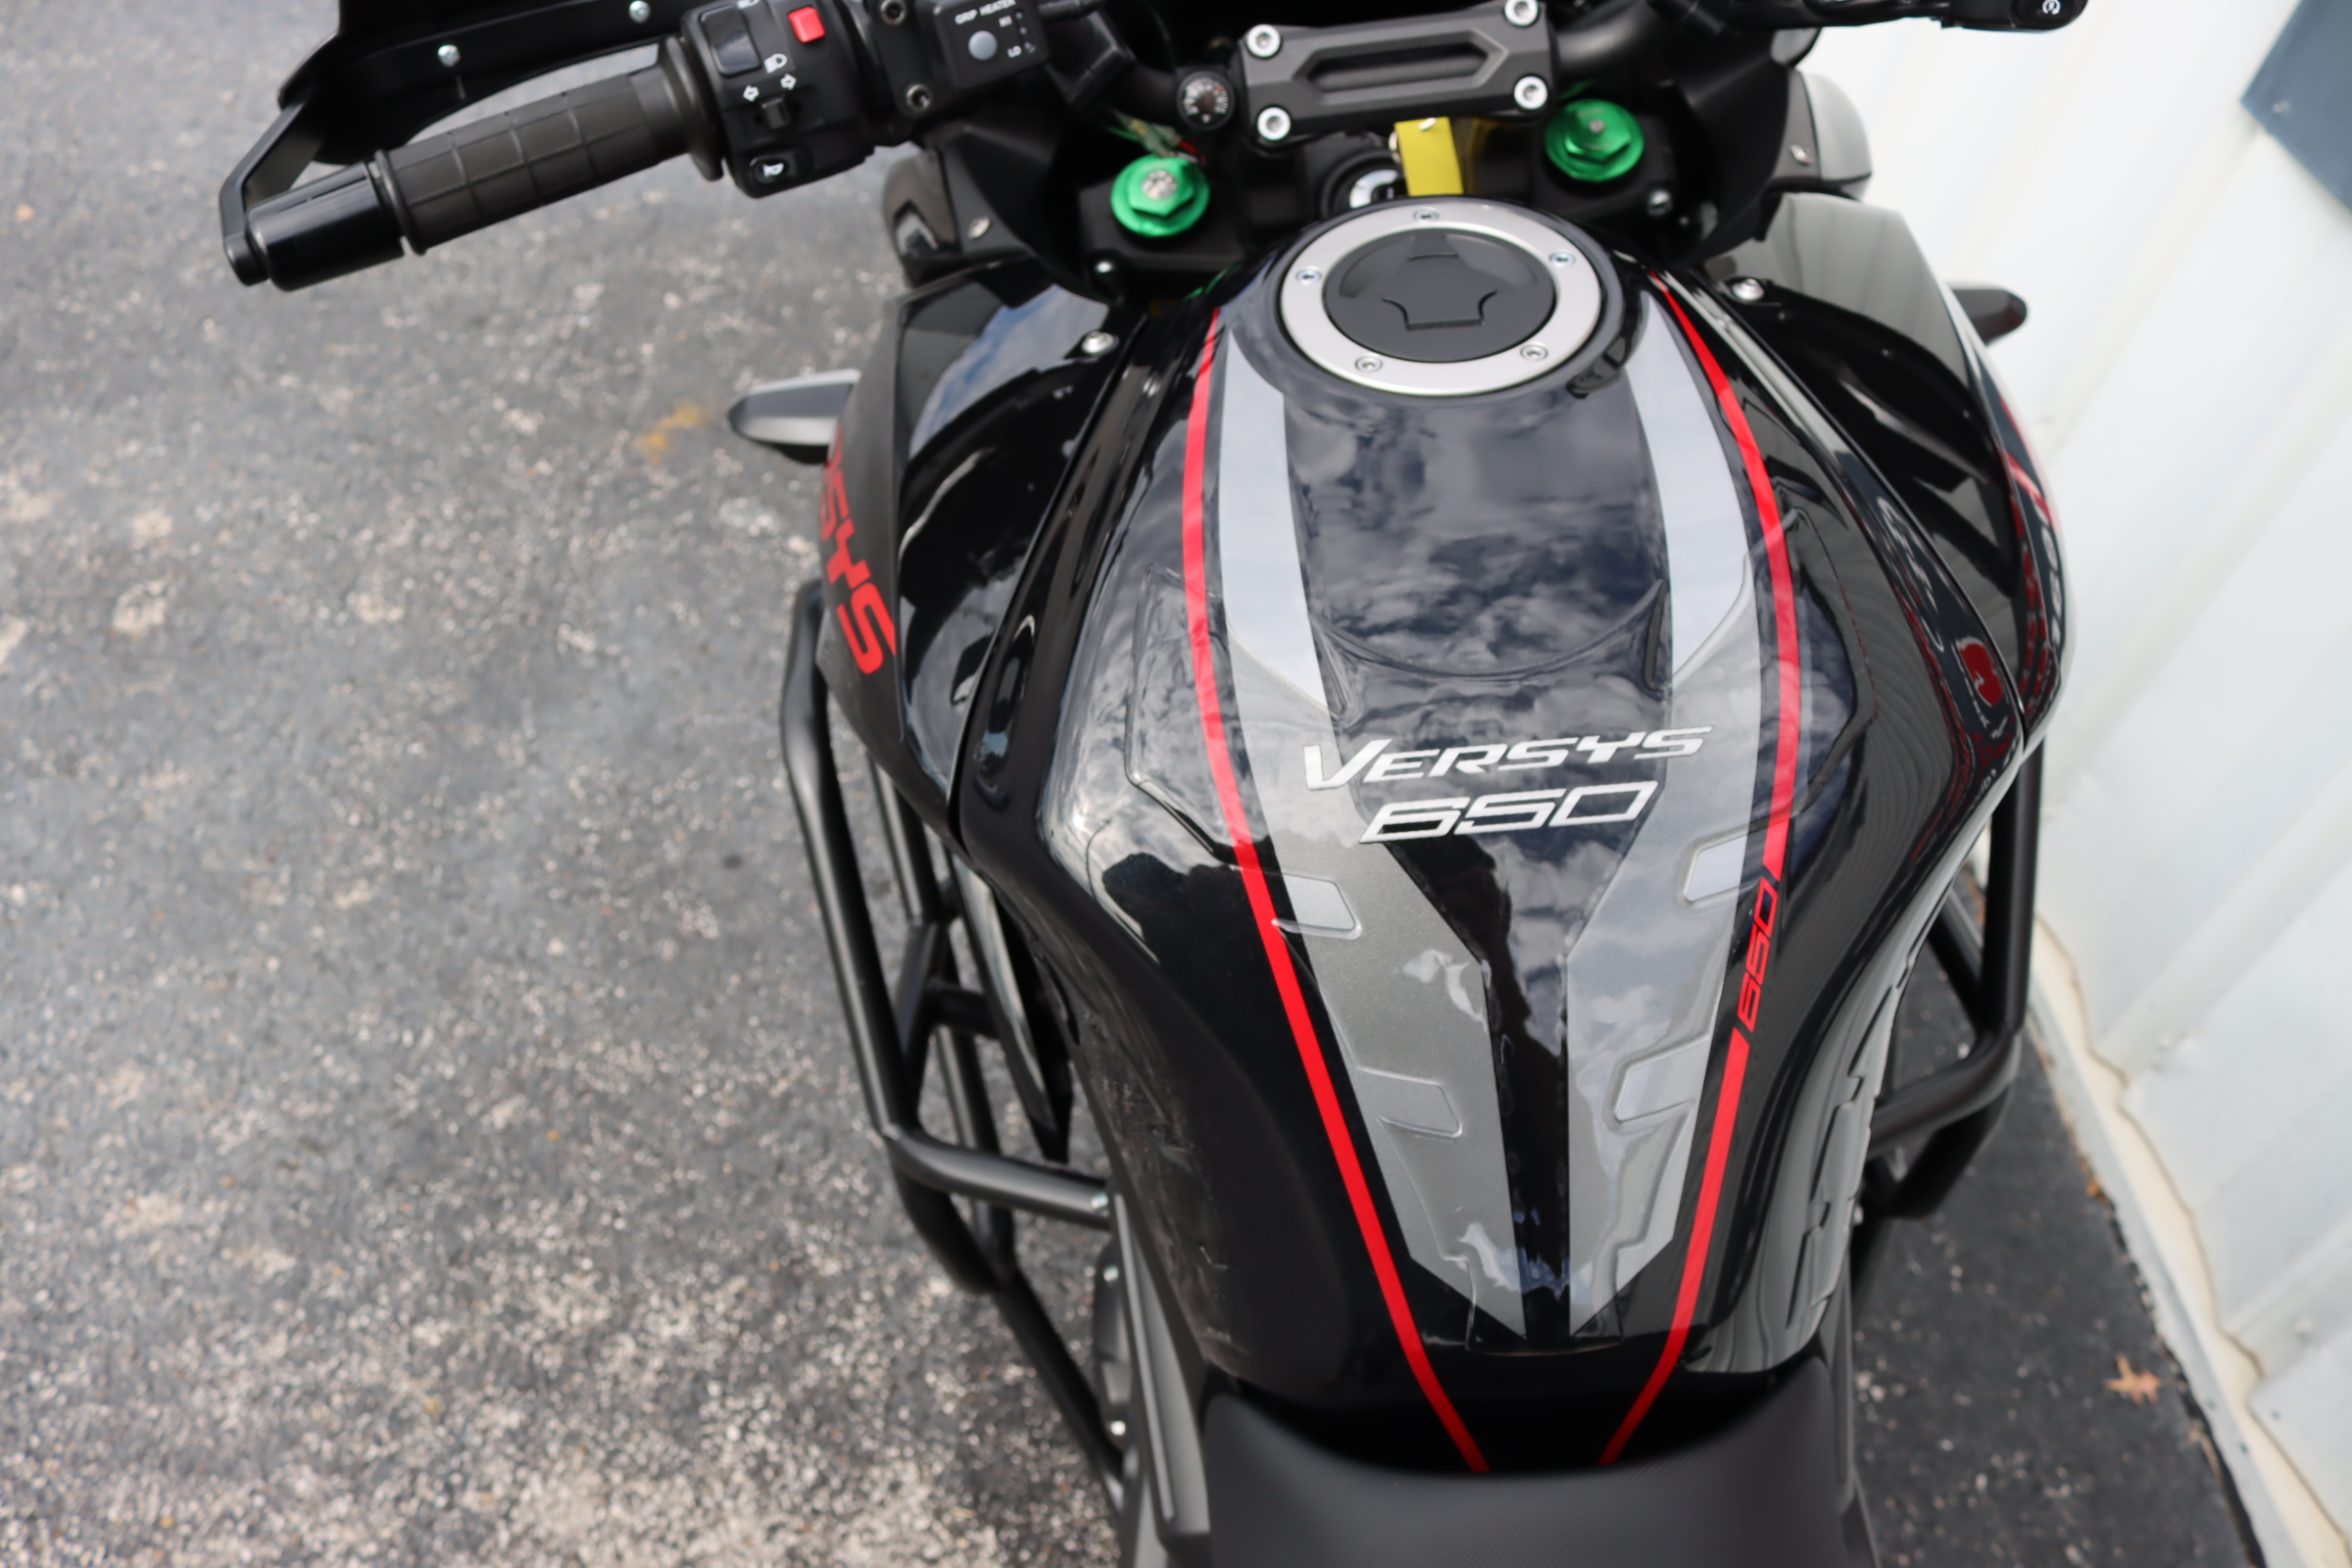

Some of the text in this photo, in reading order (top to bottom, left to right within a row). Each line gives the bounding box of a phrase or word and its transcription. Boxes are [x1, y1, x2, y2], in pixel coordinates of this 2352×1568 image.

[820, 423, 897, 674] SYS
[1303, 725, 1715, 790] VERSYS
[1359, 780, 1658, 844] 650
[1737, 877, 1779, 1033] 650
